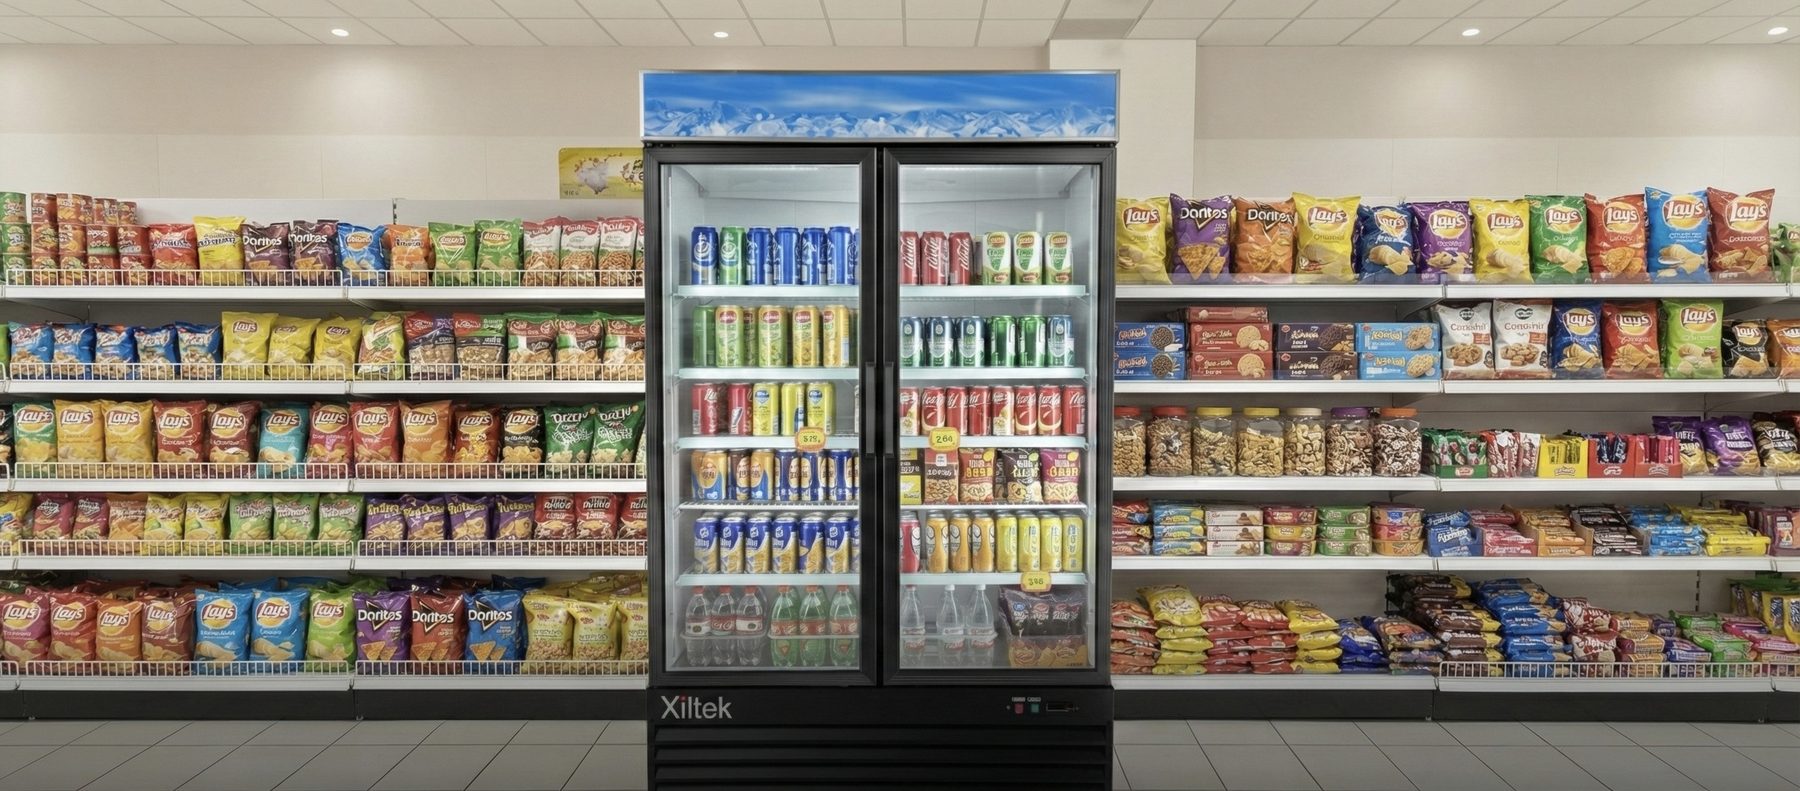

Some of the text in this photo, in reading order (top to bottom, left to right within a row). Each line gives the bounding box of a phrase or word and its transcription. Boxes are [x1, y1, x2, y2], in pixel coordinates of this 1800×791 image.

[1180, 208, 1227, 220] Doritos
[358, 609, 402, 621] Doritos
[412, 610, 454, 623] Doritos
[468, 609, 513, 621] Doritos
[661, 695, 732, 720] Xiltek
